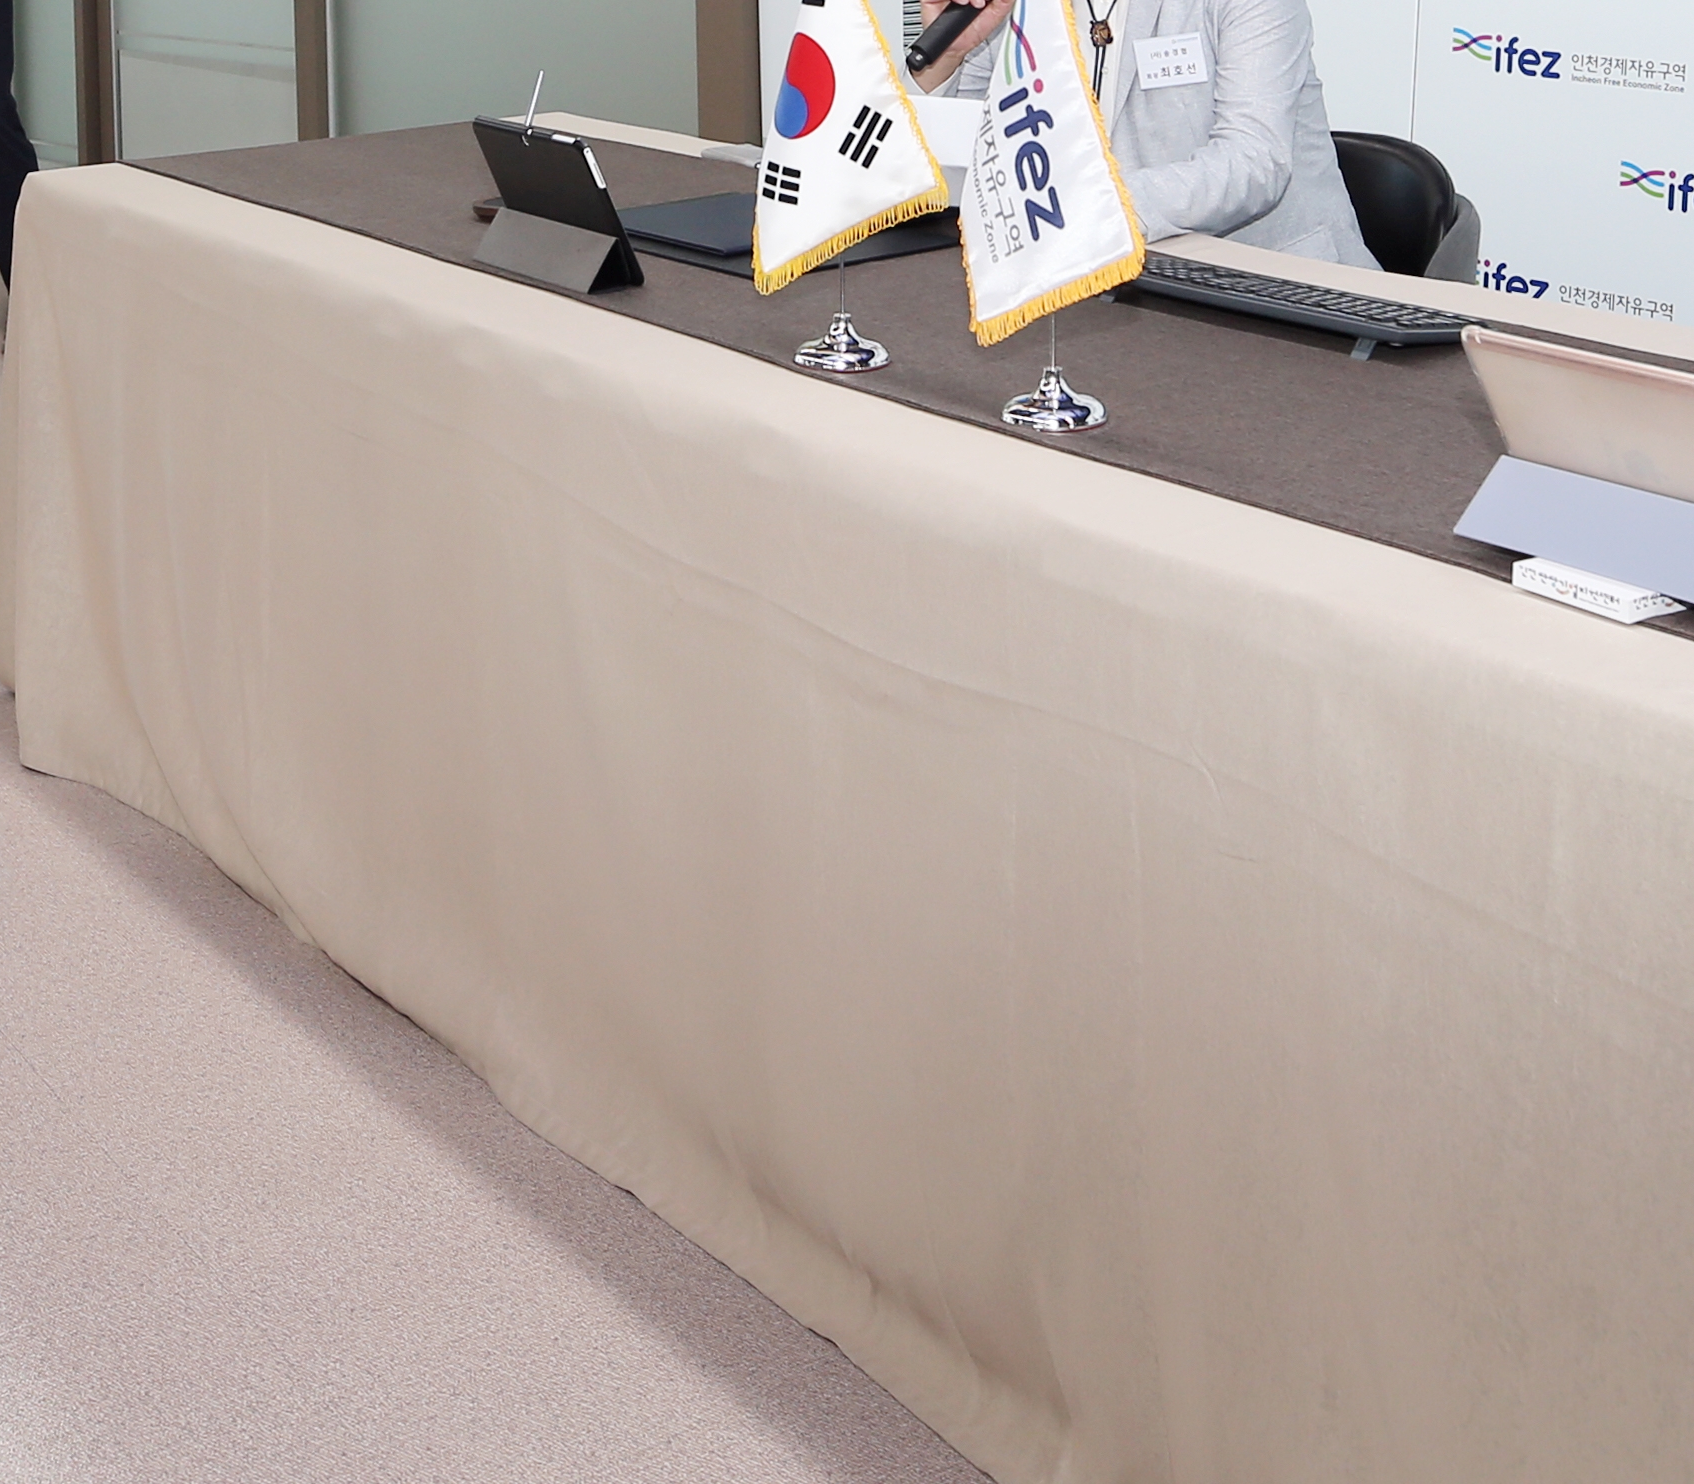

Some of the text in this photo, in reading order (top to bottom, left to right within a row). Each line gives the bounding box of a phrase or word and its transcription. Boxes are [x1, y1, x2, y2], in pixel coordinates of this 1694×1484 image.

[1495, 34, 1562, 79] ifez
[1571, 53, 1687, 82] 인천경제자유구역
[1571, 74, 1685, 94] Incheon Free Economic Zone
[998, 78, 1066, 242] ifez
[983, 220, 1000, 263] Zone
[1559, 284, 1674, 322] 인천경제자유구역
